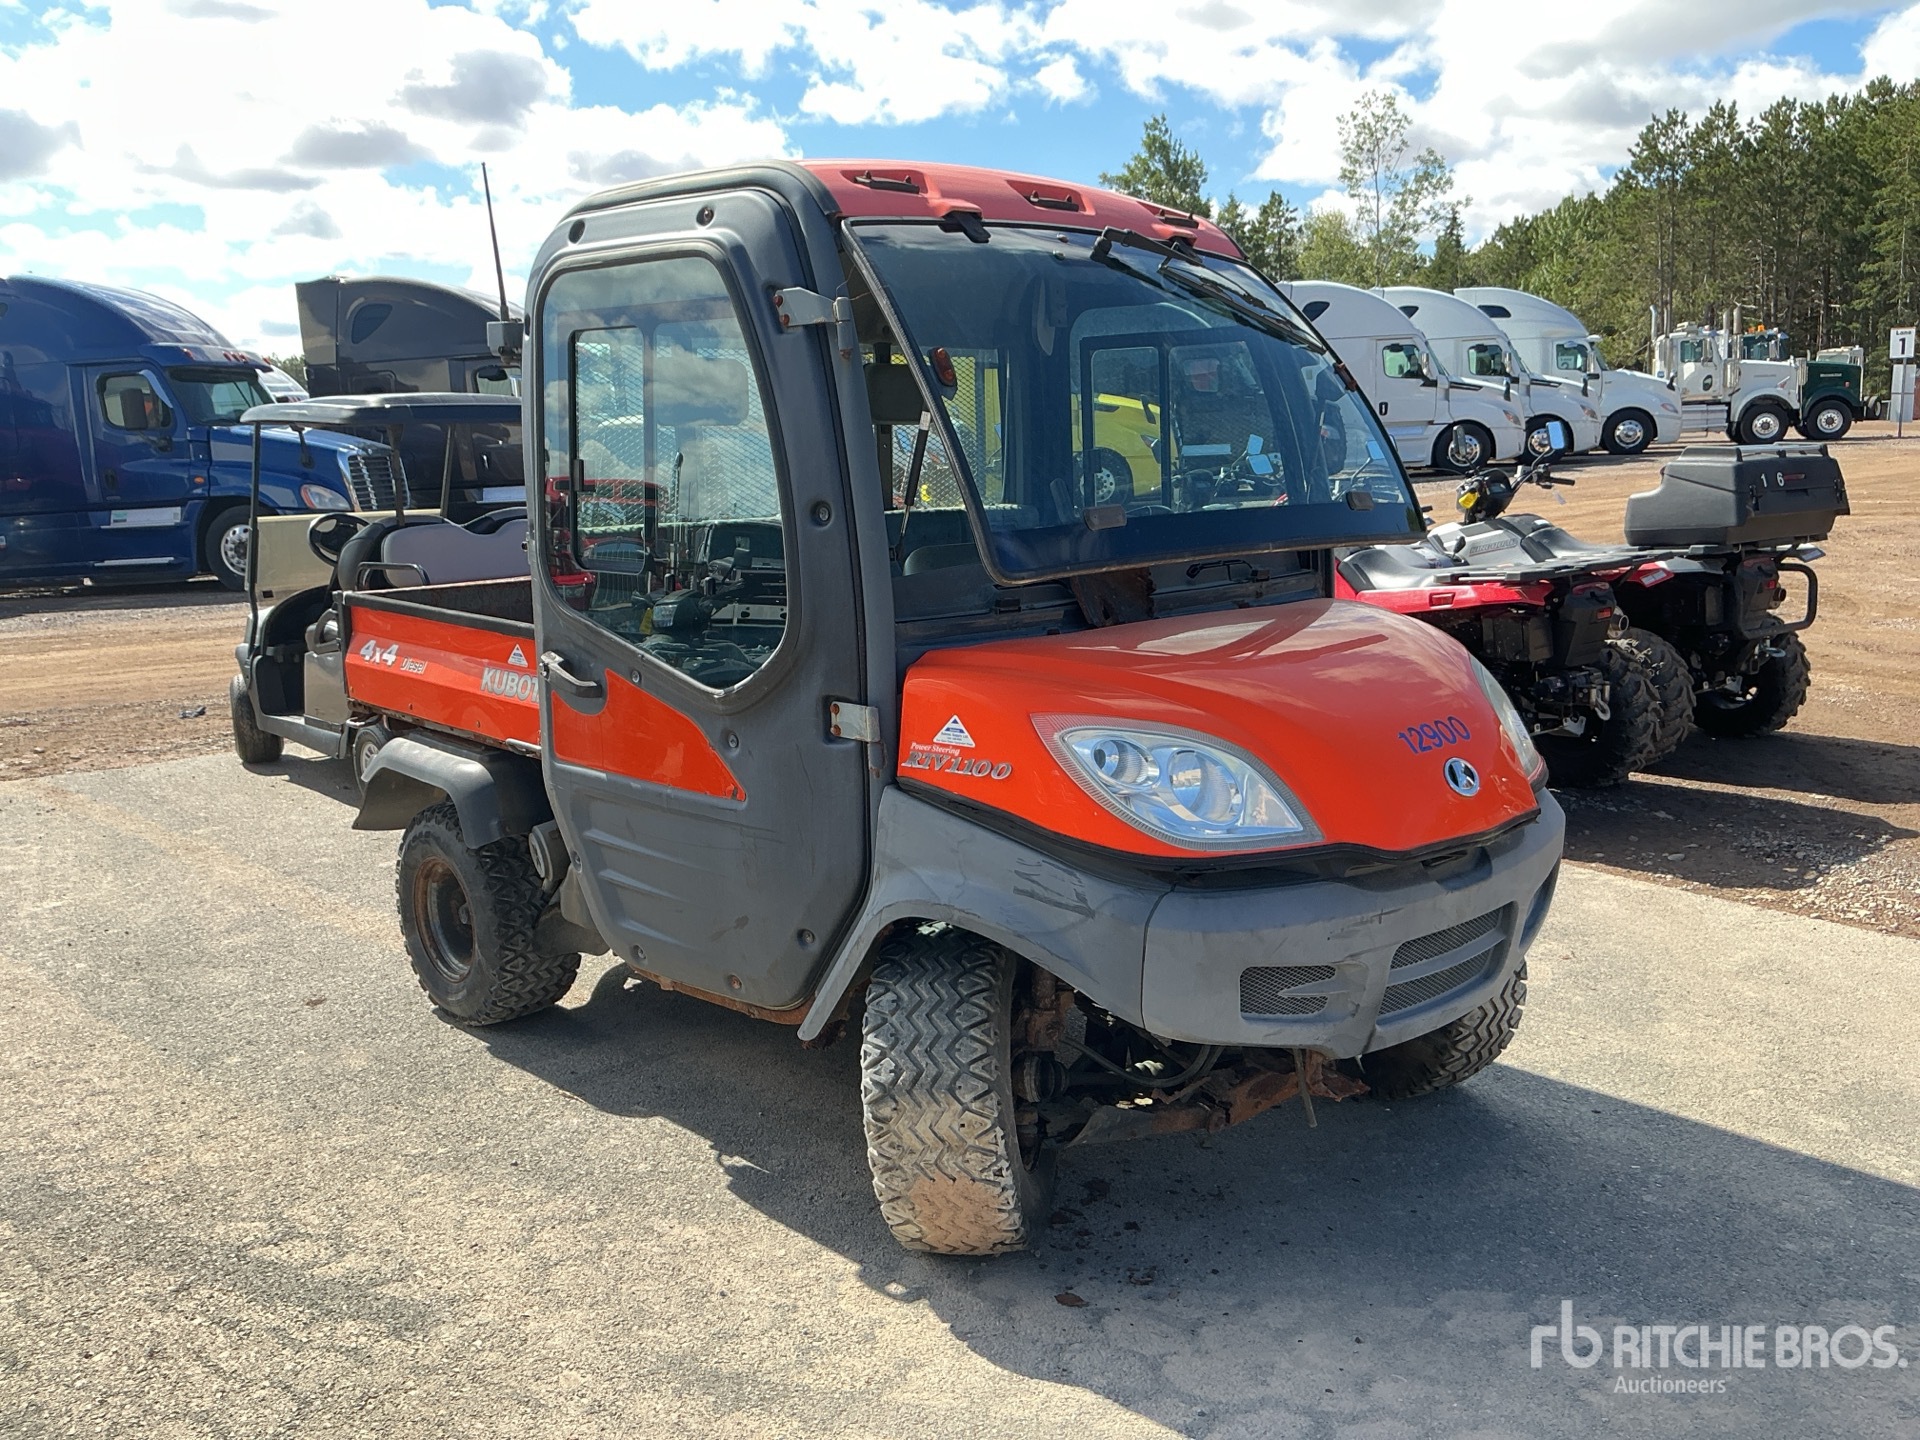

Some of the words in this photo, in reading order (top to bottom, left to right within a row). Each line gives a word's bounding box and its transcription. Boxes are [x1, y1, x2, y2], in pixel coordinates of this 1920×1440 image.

[1899, 337, 1906, 355] 1
[1776, 471, 1785, 487] 6
[360, 639, 400, 667] 4x4
[400, 655, 428, 675] Diesel
[480, 665, 539, 703] KUBOT
[910, 741, 932, 751] Power
[931, 744, 961, 757] Steering
[1398, 715, 1471, 754] 12900
[901, 750, 1013, 780] RTV1100
